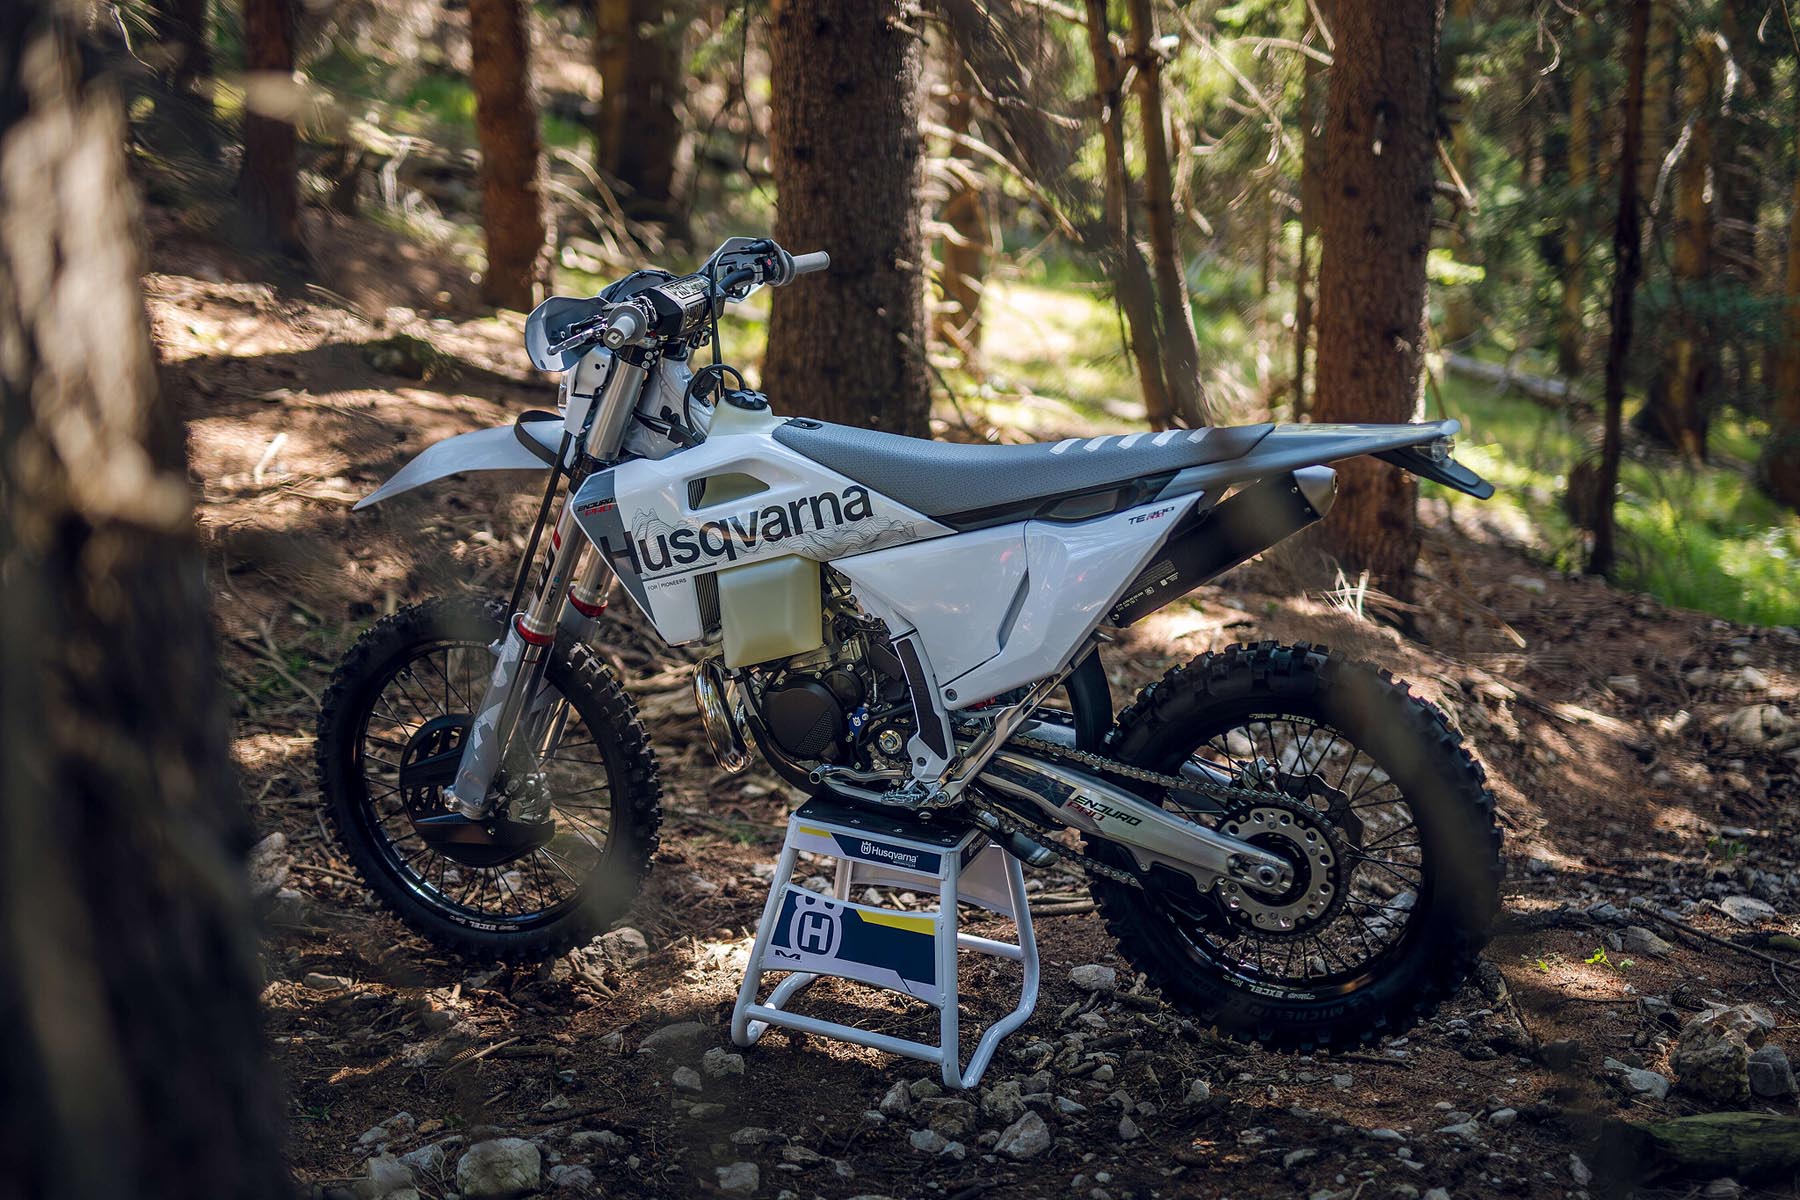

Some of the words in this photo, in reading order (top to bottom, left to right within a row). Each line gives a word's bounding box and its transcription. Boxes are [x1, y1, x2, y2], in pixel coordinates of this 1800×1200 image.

[577, 497, 614, 512] ENDURO
[600, 485, 874, 576] Husqvarna
[660, 578, 687, 589] PIONEERS
[1281, 713, 1318, 726] EXCEL
[1067, 801, 1105, 821] PRO
[1073, 795, 1143, 827] ENDURO
[871, 846, 917, 863] Husqvarna
[469, 920, 497, 931] EXCEL
[1249, 984, 1285, 999] EXCEL
